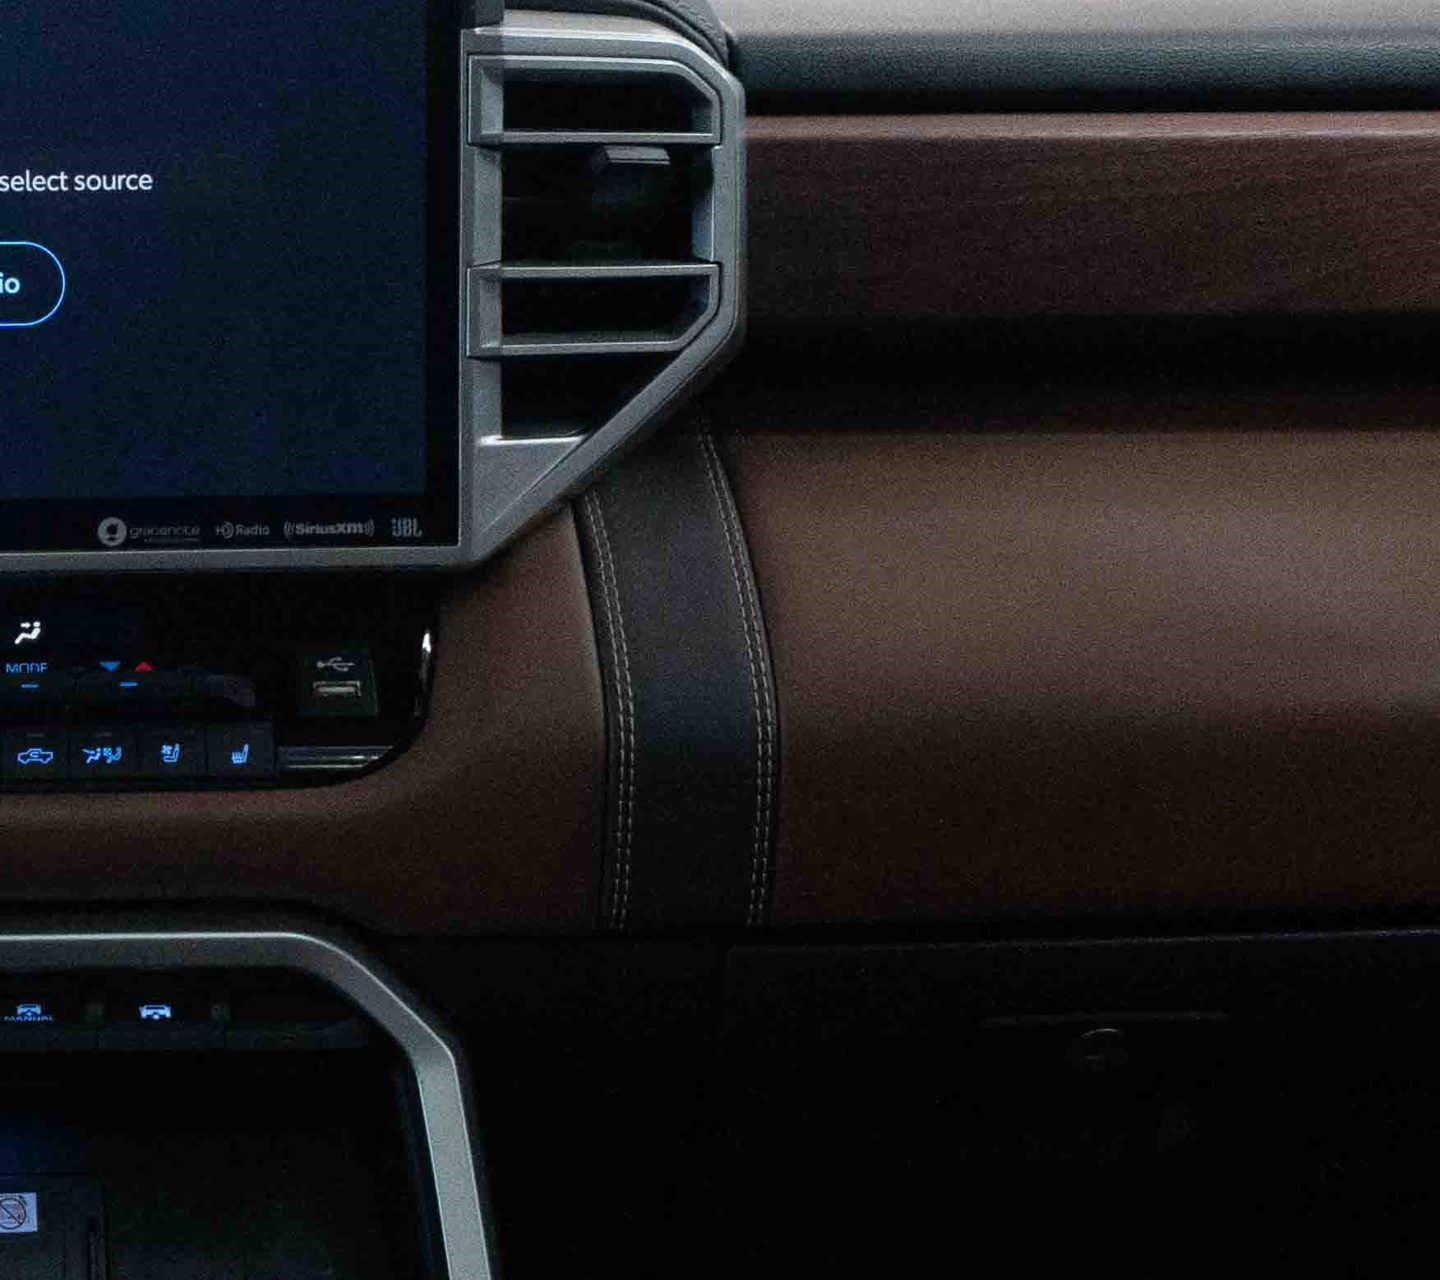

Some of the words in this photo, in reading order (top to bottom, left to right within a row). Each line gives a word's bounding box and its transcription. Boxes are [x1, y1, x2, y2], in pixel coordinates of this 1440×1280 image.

[74, 173, 154, 191] source
[235, 524, 271, 536] Radio
[391, 517, 423, 537] JBL
